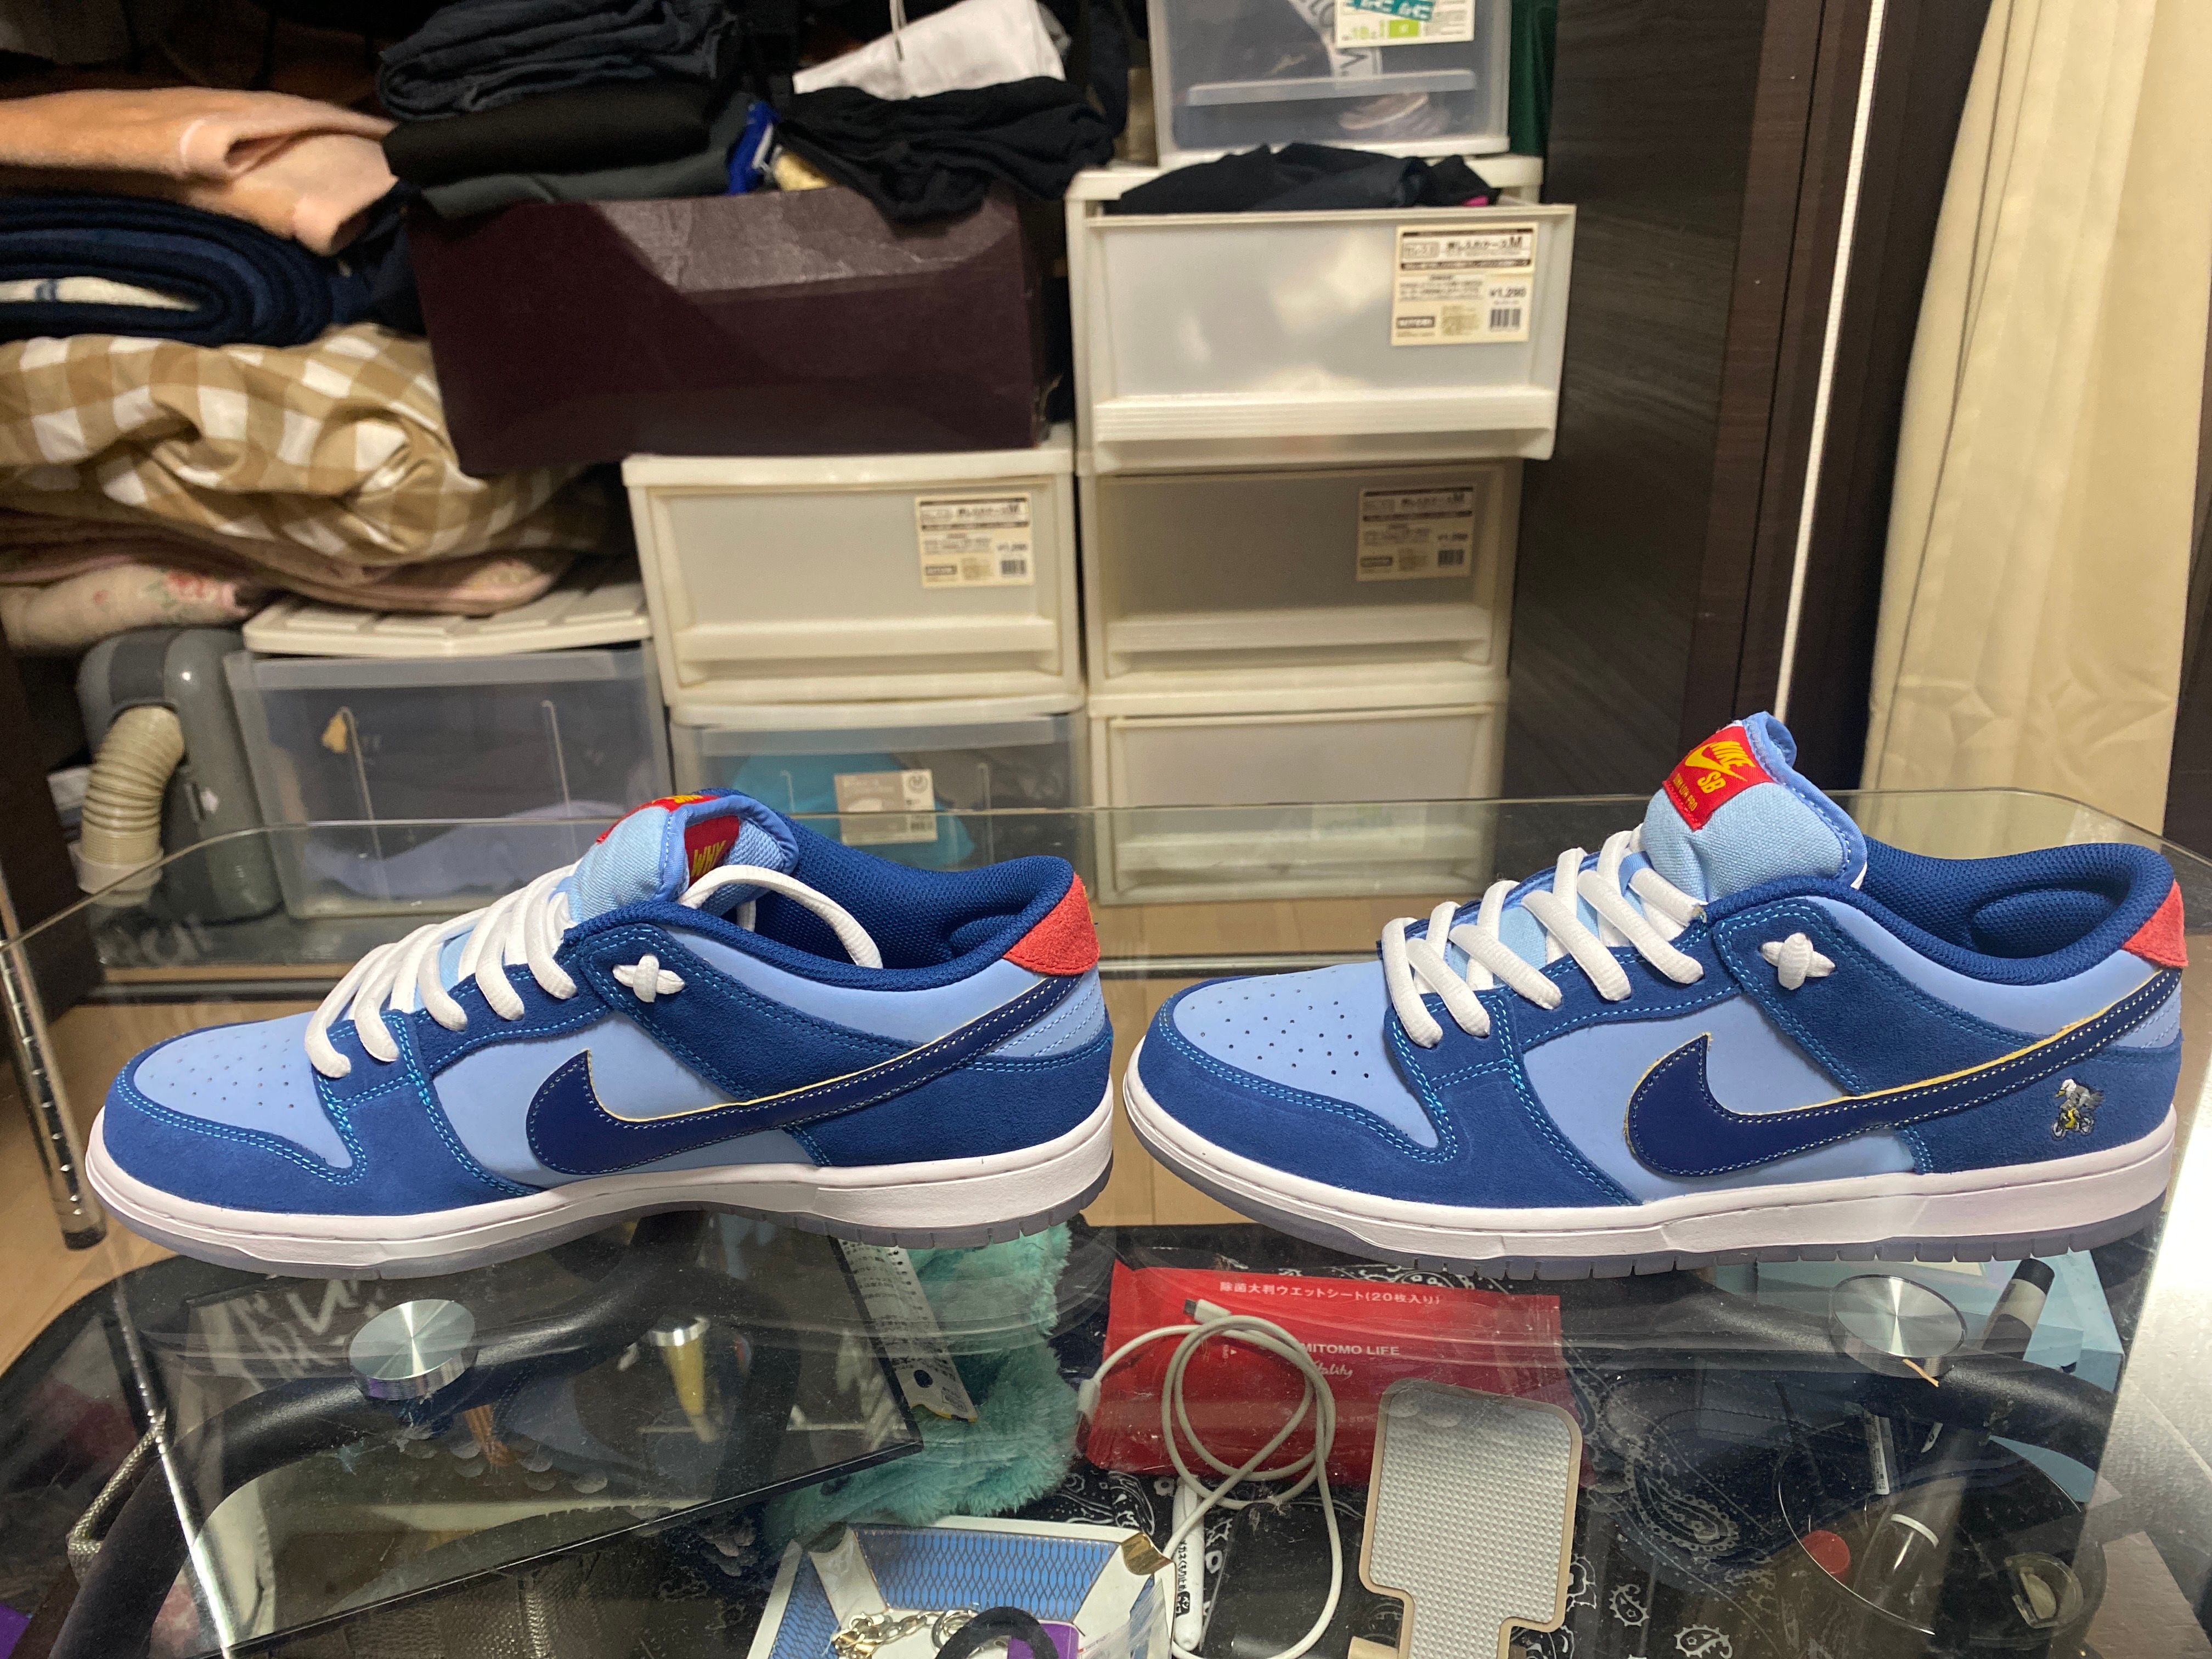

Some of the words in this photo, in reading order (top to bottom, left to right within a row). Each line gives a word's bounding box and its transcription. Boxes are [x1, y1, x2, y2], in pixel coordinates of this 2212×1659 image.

[1709, 741, 1756, 768] NIKE
[1697, 771, 1726, 794] SB
[1302, 1343, 1363, 1355] MITOMO
[1366, 1346, 1400, 1356] LIFE
[1316, 1360, 1353, 1380] tality
